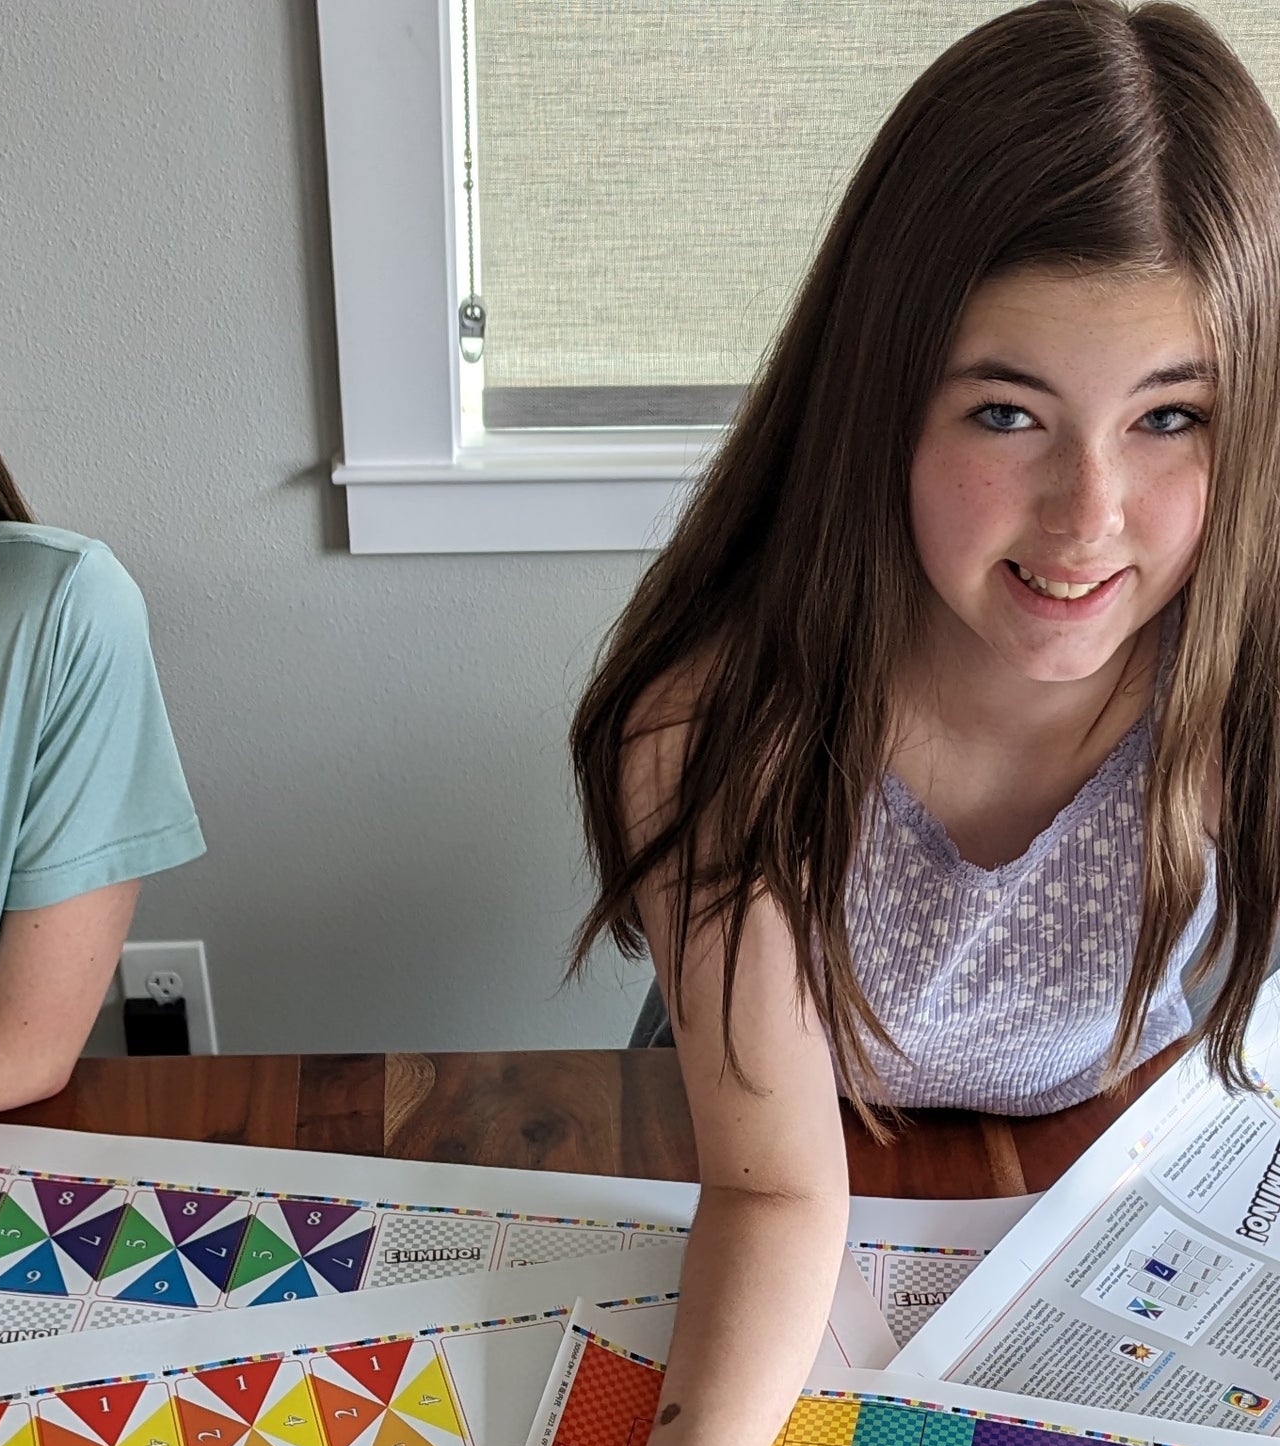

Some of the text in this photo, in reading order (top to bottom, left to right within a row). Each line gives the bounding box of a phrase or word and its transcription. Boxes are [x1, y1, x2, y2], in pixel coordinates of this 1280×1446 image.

[385, 1247, 481, 1264] ELIMINO!
[371, 1356, 381, 1371] 1
[236, 1376, 247, 1391] 1
[99, 1398, 110, 1412] 1
